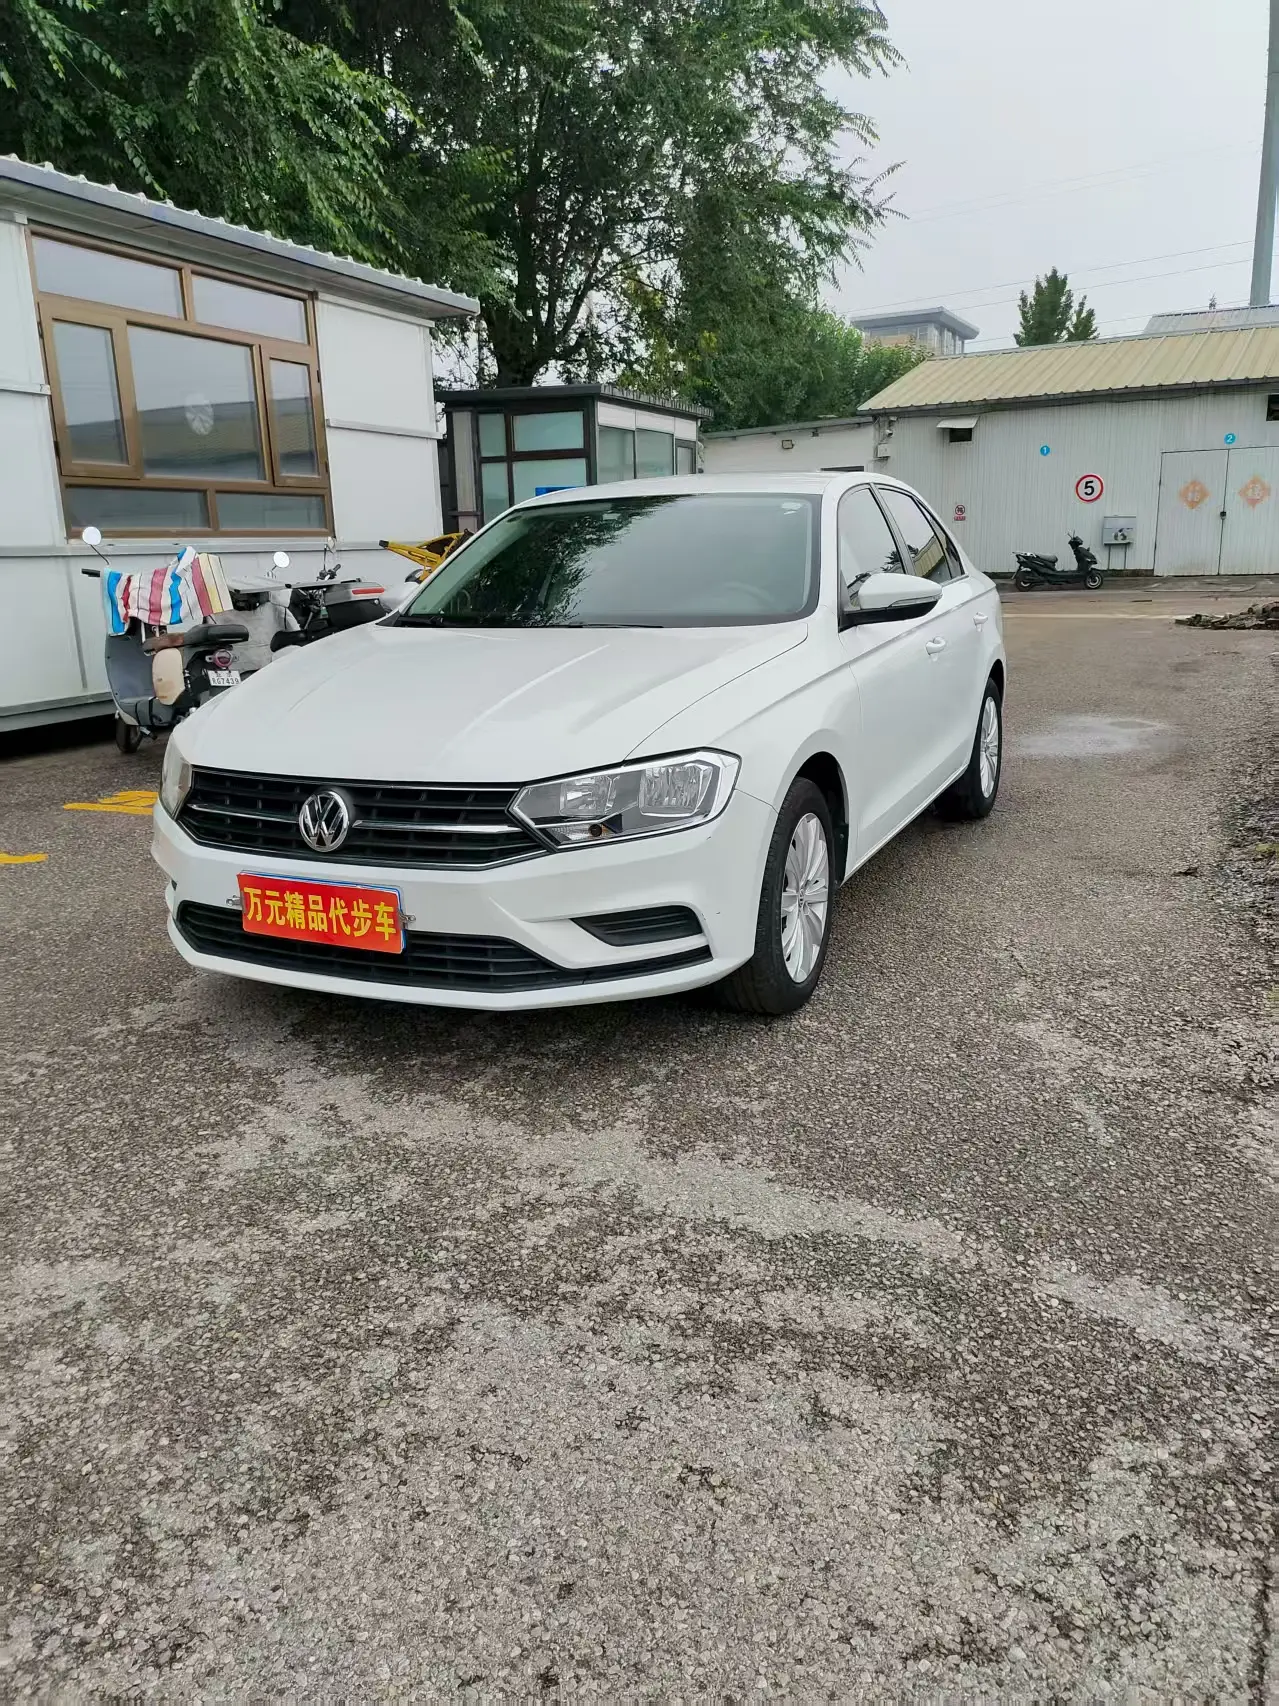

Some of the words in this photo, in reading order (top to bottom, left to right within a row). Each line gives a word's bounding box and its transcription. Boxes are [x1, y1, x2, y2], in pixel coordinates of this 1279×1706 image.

[1226, 434, 1233, 443] 2
[1084, 480, 1095, 496] 5
[244, 887, 397, 941] 万元精品代步车
